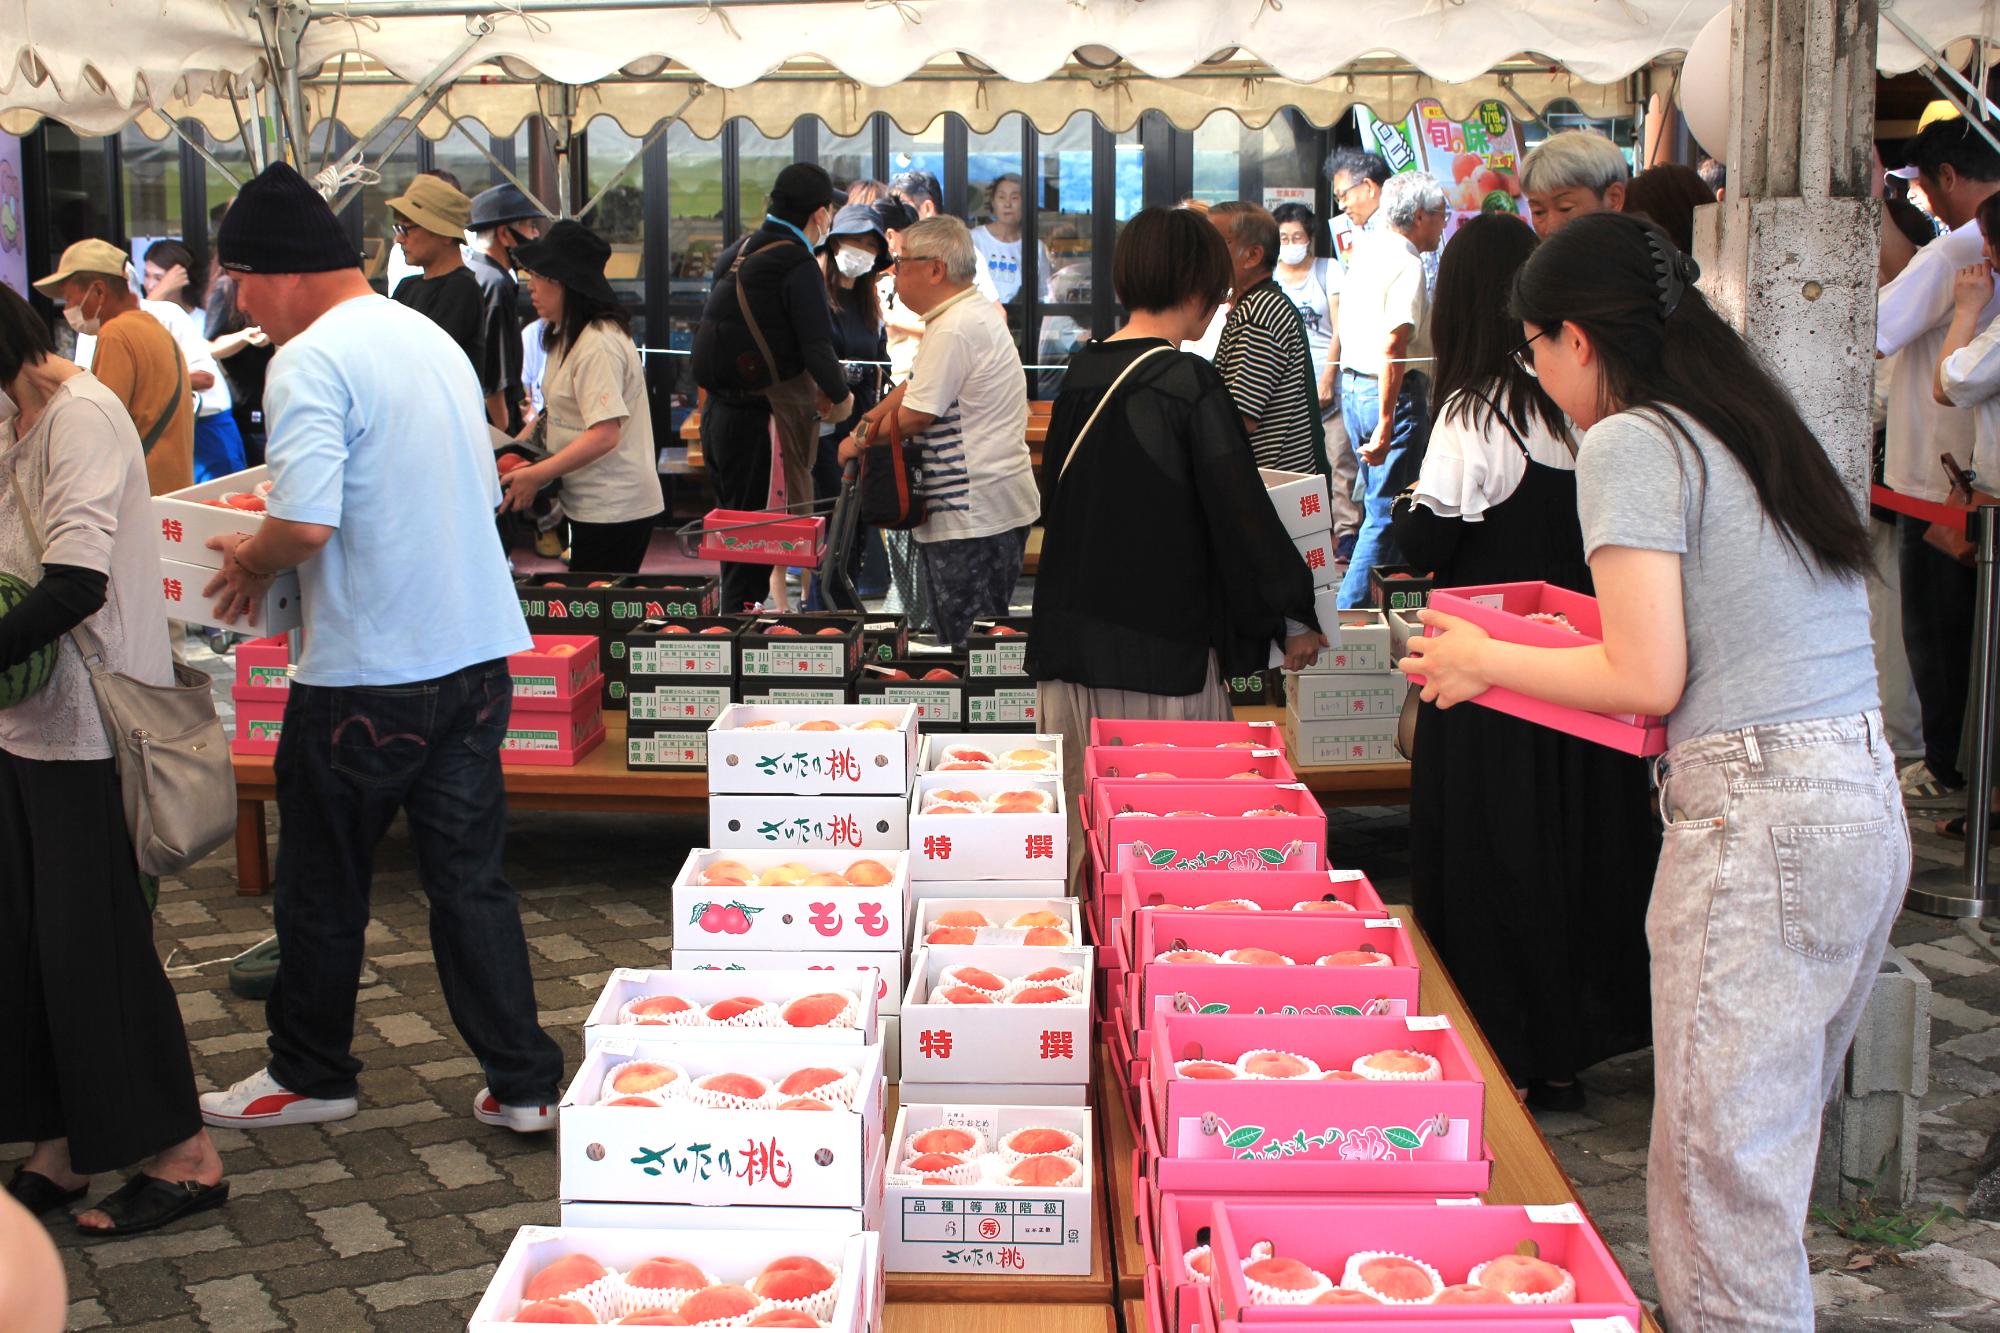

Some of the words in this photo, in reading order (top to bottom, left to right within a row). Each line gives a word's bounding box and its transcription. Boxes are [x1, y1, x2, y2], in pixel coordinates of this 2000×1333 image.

[1427, 118, 1490, 154] 旬の味
[1481, 152, 1516, 170] フェア
[1300, 493, 1321, 518] 撰
[162, 518, 184, 543] 特
[1305, 547, 1326, 570] 撰
[163, 577, 184, 602] 特
[632, 651, 657, 661] 香川
[744, 652, 769, 662] 香川
[971, 654, 997, 664] 香川
[632, 663, 657, 673] 県産
[744, 663, 769, 674] 県産
[971, 665, 997, 675] 県産
[632, 696, 657, 706] 香川
[971, 700, 996, 710] 香川
[632, 708, 657, 718] 県産
[971, 711, 996, 721] 県産
[631, 741, 655, 751] 香川
[631, 752, 655, 762] 県産
[755, 747, 861, 782] さいたの桃
[756, 813, 863, 848] さいたの桃
[924, 835, 952, 859] 特
[1025, 835, 1053, 859] 撰
[808, 902, 889, 936] もも
[919, 1030, 953, 1059] 特
[1039, 1030, 1073, 1059] 撰
[948, 1118, 990, 1127] なつおとめ
[630, 1136, 793, 1189] さいたの桃
[913, 1200, 954, 1212] 品種
[970, 1201, 1007, 1213] 等級
[1019, 1202, 1056, 1214] 階級
[982, 1221, 997, 1236] 秀
[942, 1246, 1025, 1270] さいたの桃
